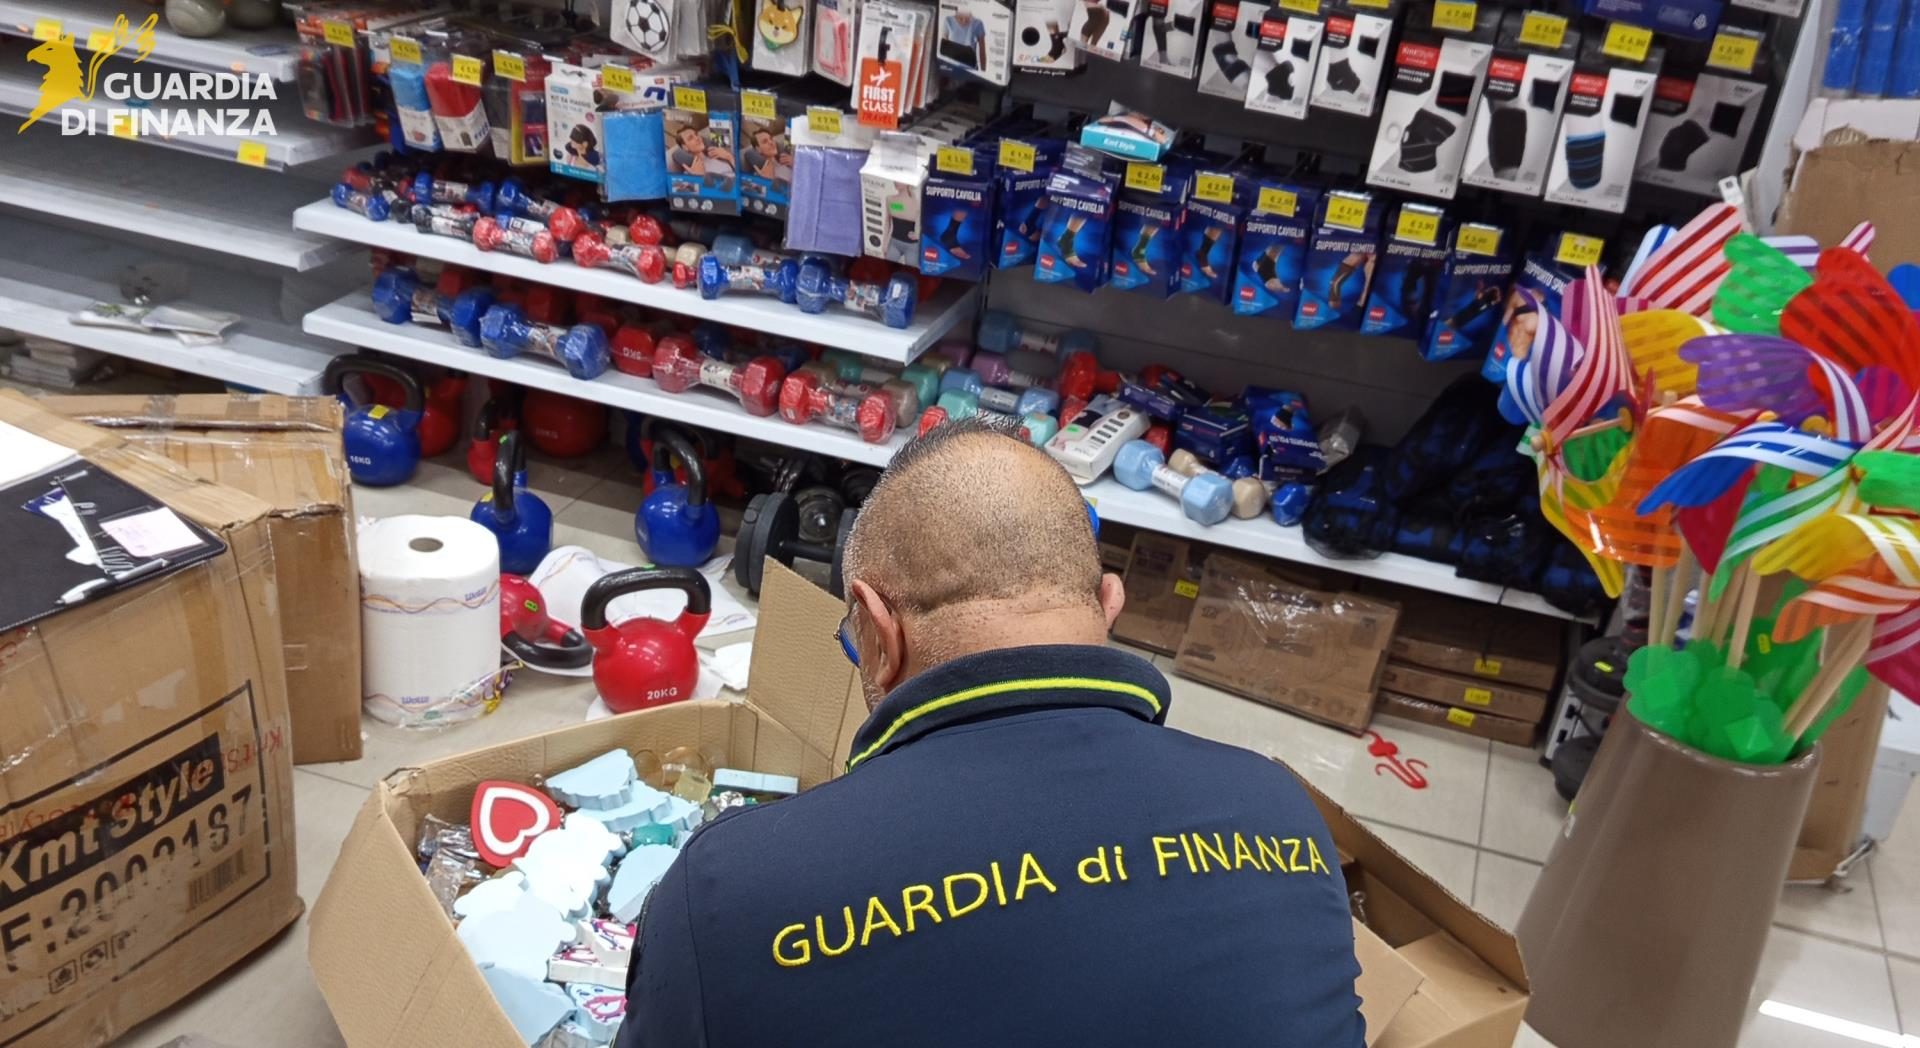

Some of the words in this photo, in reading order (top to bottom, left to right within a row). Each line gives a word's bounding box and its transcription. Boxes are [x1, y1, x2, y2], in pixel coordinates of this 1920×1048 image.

[862, 85, 896, 103] FIRST
[862, 99, 895, 114] CLASS
[1014, 179, 1041, 191] SUPPORTO
[925, 186, 956, 199] SUPPORTO
[955, 189, 982, 202] CAVIGLIA
[1077, 200, 1105, 215] CAVIGLIA
[1145, 207, 1171, 221] CAVIGLIA
[1212, 208, 1236, 225] CAVIGLIA
[1246, 222, 1277, 235] SUPPORTO
[1277, 225, 1305, 238] CAVIGLIA
[1316, 240, 1349, 252] SUPPORTO
[1387, 244, 1421, 258] SUPPORTO
[1453, 264, 1489, 275] SUPPORTO
[1524, 259, 1554, 287] SUPPORTO
[647, 687, 678, 701] 20KG
[0, 808, 101, 893] Kmt
[110, 758, 215, 839] Style
[771, 852, 1057, 968] GUARDIA
[1076, 846, 1129, 884] di
[1151, 832, 1331, 877] FINANZA
